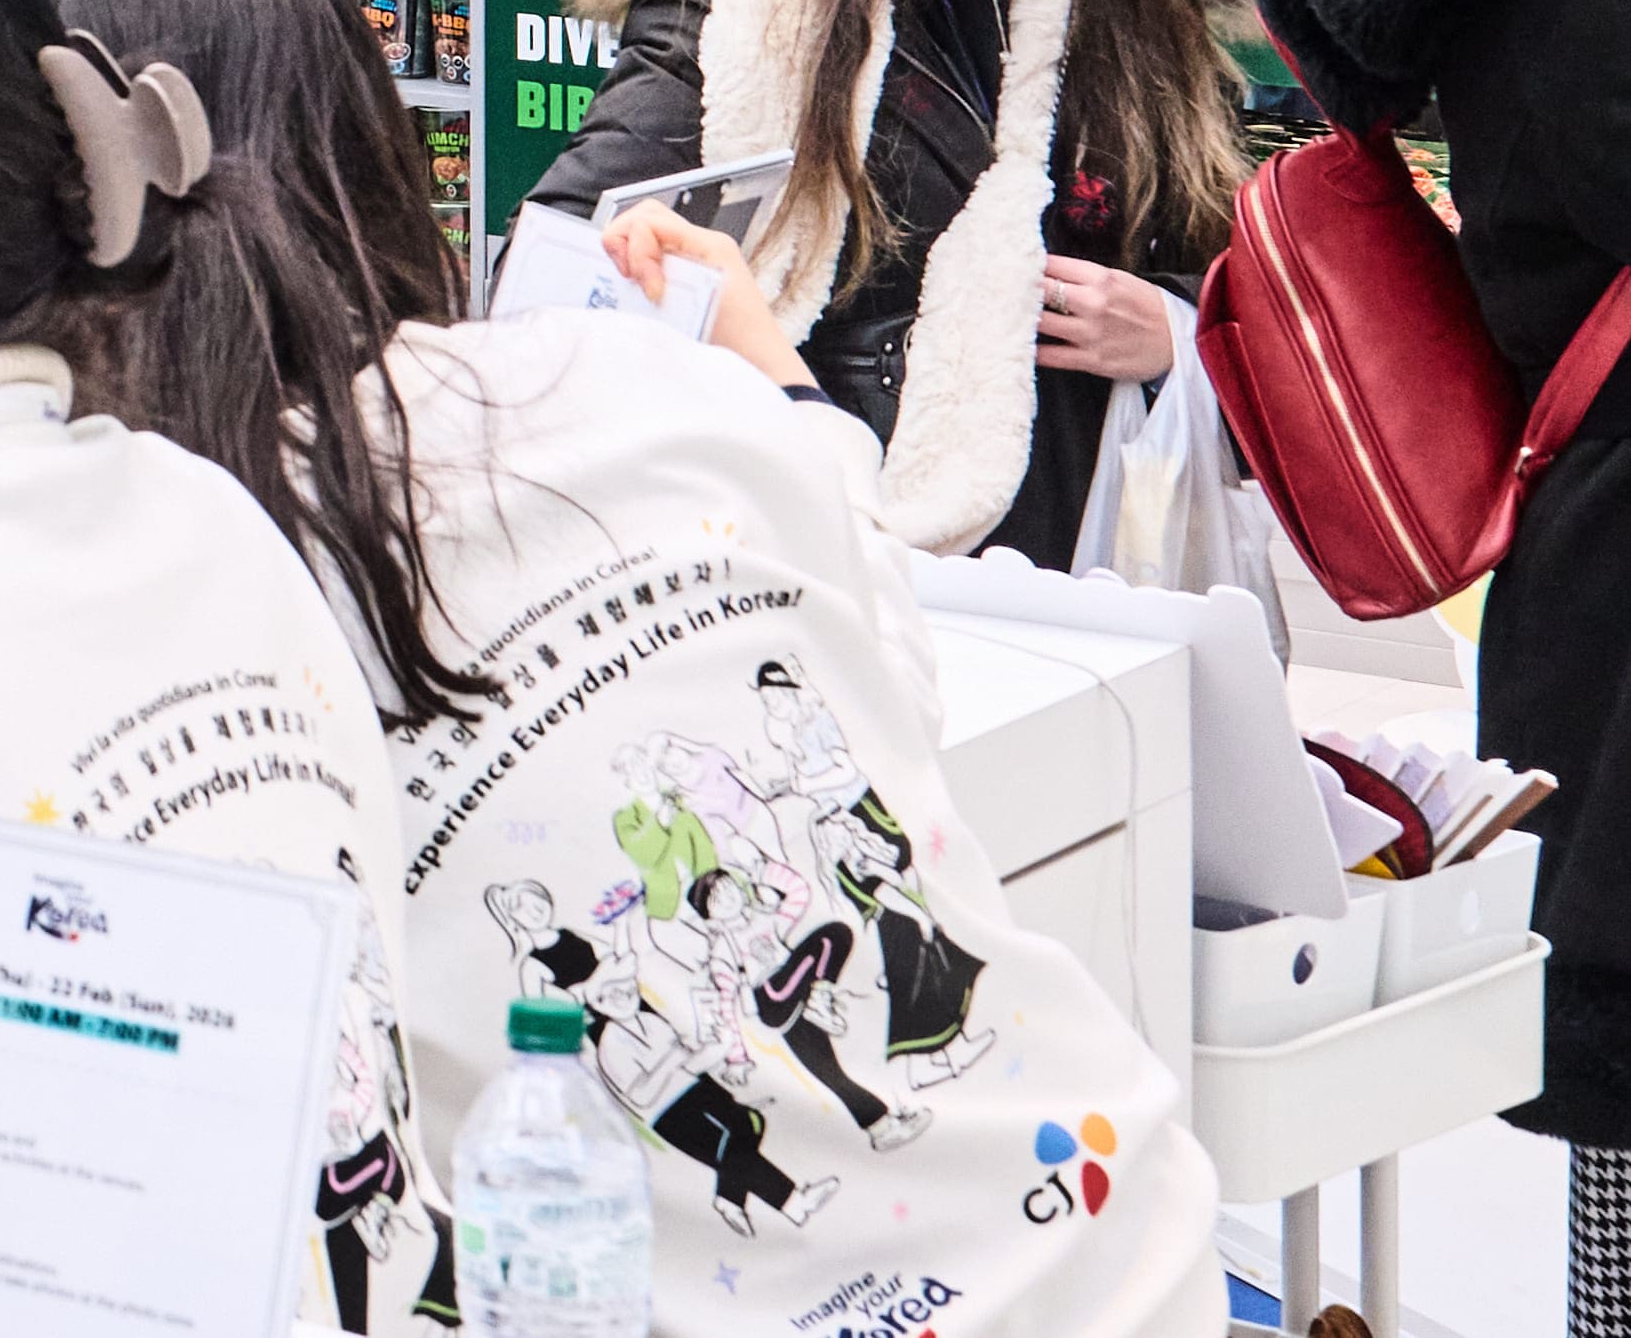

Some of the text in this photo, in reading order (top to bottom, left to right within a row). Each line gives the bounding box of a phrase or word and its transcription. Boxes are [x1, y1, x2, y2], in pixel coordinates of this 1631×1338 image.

[480, 588, 575, 663] quotidiana
[576, 572, 596, 593] in
[405, 588, 804, 895] Experience Everyday Life in Korea!
[153, 767, 251, 825] Everyday
[253, 752, 292, 783] Life
[1023, 1171, 1074, 1224] CJ
[790, 1270, 877, 1332] Imagine
[857, 1272, 904, 1321] your
